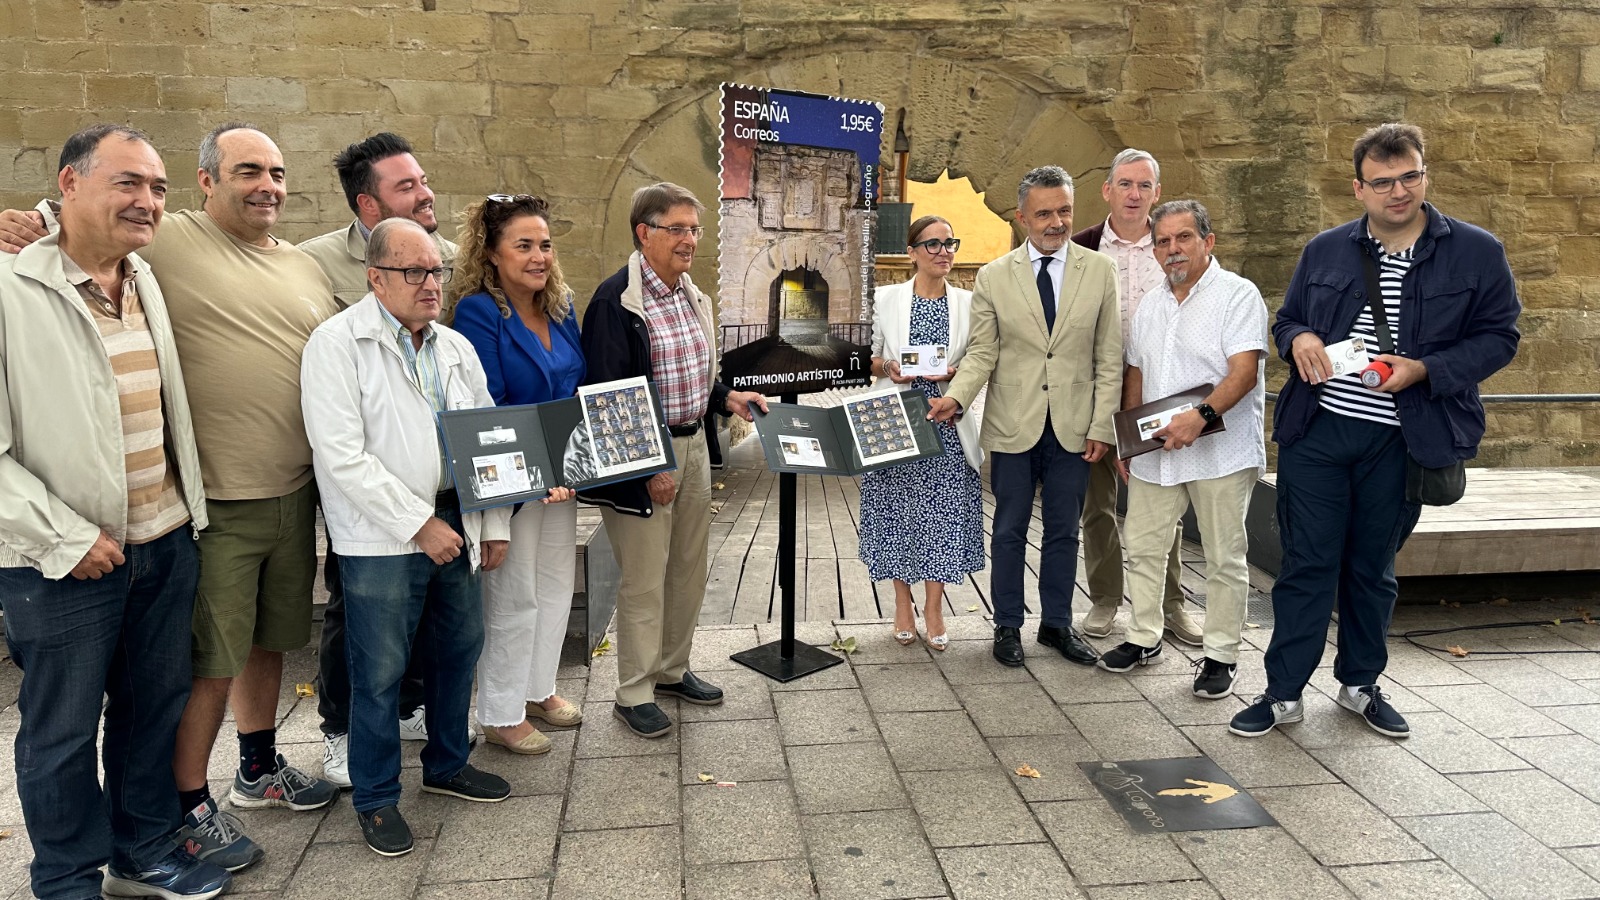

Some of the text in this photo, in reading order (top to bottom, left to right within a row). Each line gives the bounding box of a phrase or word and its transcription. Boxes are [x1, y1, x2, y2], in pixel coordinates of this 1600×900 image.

[734, 100, 790, 124] ESPAÑA
[840, 112, 875, 133] 1,95€
[733, 124, 780, 142] Correos
[859, 164, 873, 321] Puerta del Revellín. Logroño
[733, 368, 844, 387] PATRIMONIO ARTÍSTICO
